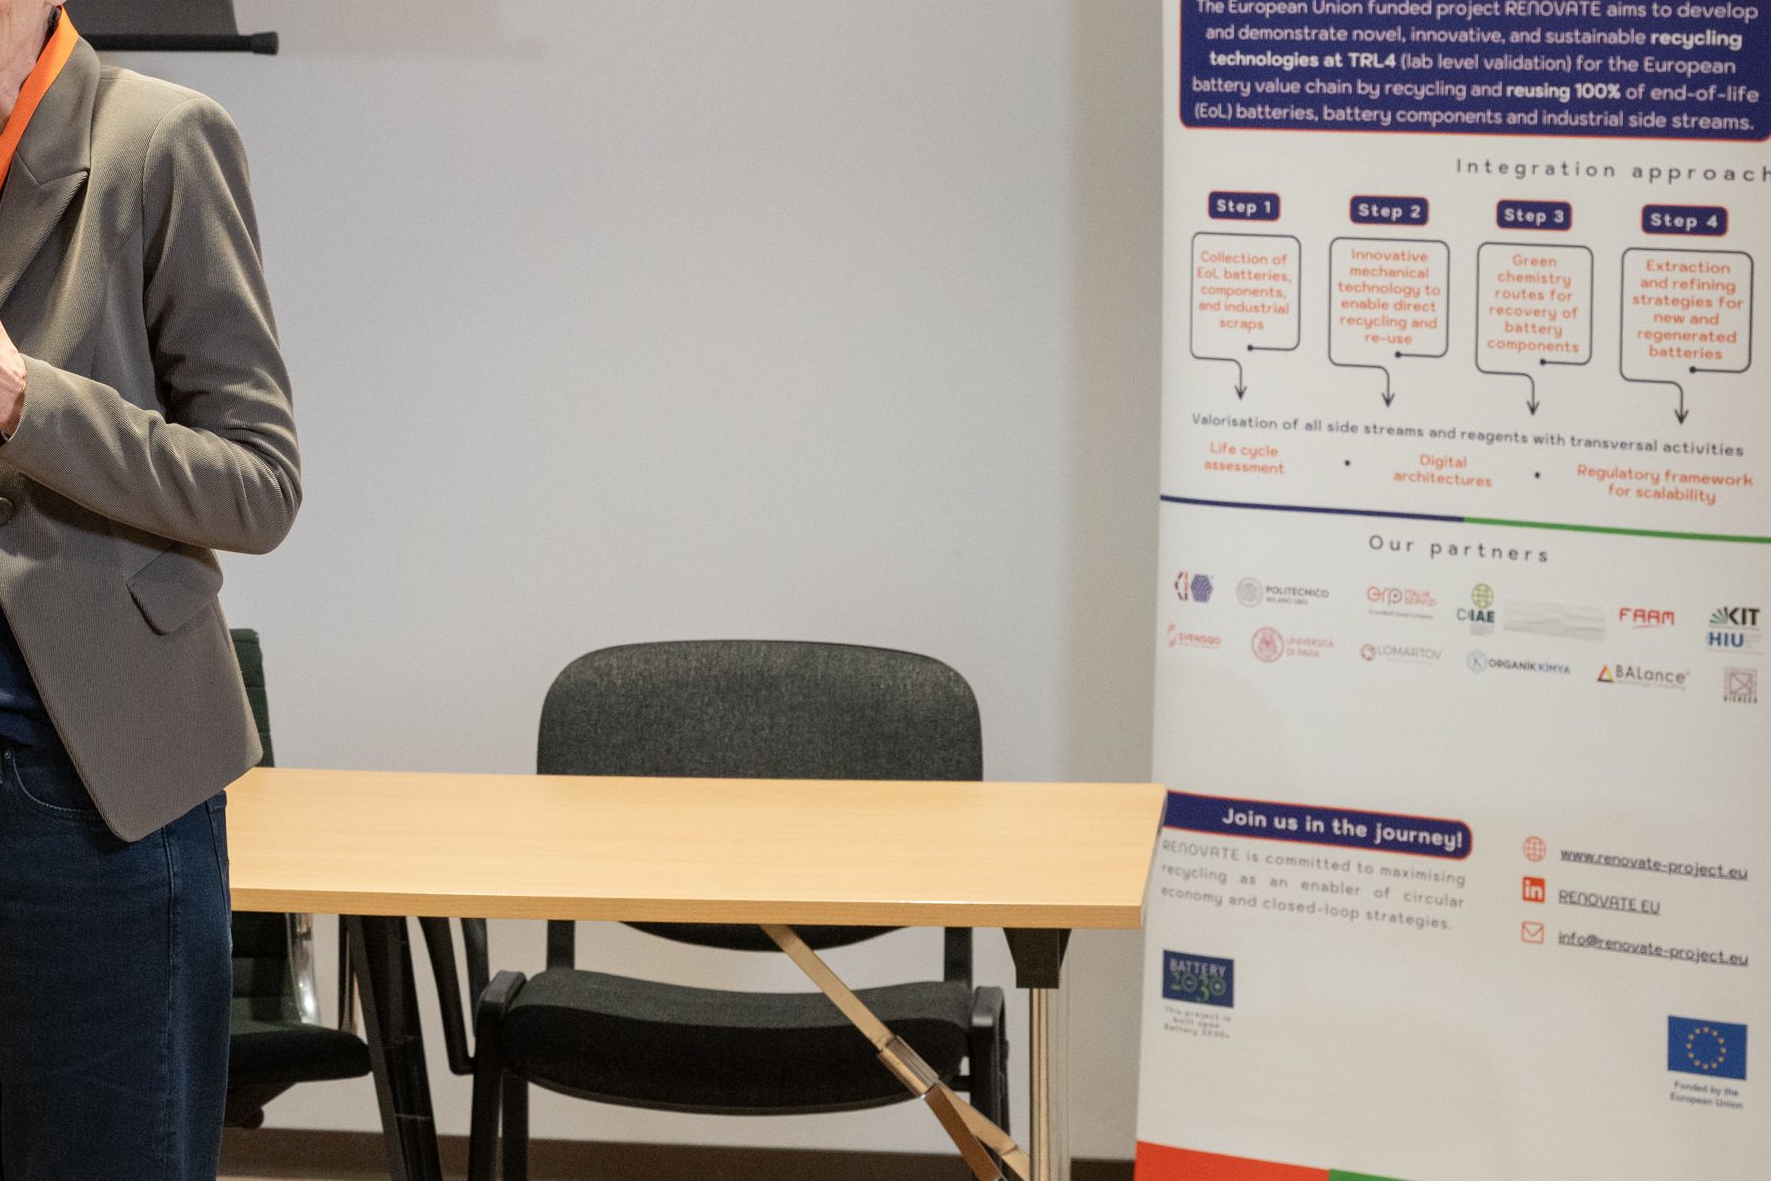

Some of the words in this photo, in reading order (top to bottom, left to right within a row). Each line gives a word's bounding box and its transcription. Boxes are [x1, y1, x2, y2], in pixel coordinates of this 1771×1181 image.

[1312, 0, 1363, 15] Union
[1436, 0, 1500, 21] project
[1505, 0, 1600, 17] RENOVATE
[1607, 1, 1646, 18] aims
[1652, 2, 1672, 18] to
[1677, 2, 1758, 24] develop
[1206, 24, 1234, 40] and
[1238, 24, 1348, 42] demonstrate
[1353, 25, 1406, 42] novel,
[1411, 27, 1505, 44] innovative,
[1510, 28, 1541, 43] and
[1546, 28, 1646, 45] sustainable
[1651, 29, 1742, 50] recycling
[1210, 50, 1319, 72] technologies
[1324, 52, 1343, 68] at
[1348, 51, 1396, 69] TRL4
[1401, 53, 1433, 70] (lab
[1438, 54, 1478, 69] level
[1484, 54, 1571, 72] validation)
[1577, 54, 1602, 72] for
[1609, 56, 1638, 72] the
[1644, 56, 1735, 77] European
[1193, 77, 1250, 97] battery
[1255, 77, 1301, 93] value
[1305, 79, 1352, 94] chain
[1357, 78, 1380, 100] by
[1385, 81, 1466, 101] recycling
[1471, 82, 1502, 97] and
[1506, 83, 1570, 103] reusing
[1575, 82, 1621, 100] 100%
[1626, 83, 1645, 100] of
[1651, 84, 1759, 102] end-of-life
[1195, 102, 1232, 120] (EoL)
[1236, 103, 1318, 122] batteries,
[1323, 105, 1391, 127] battery
[1396, 109, 1502, 128] components
[1507, 109, 1538, 125] and
[1543, 109, 1623, 127] industrial
[1629, 111, 1666, 128] side
[1672, 113, 1753, 130] streams.
[1457, 159, 1615, 180] Integration
[1216, 199, 1257, 218] Step
[1264, 200, 1271, 214] 1
[1357, 204, 1403, 222] Step
[1410, 205, 1421, 219] 2
[1503, 208, 1547, 227] Step
[1553, 209, 1565, 224] 3
[1649, 213, 1698, 233] Step
[1706, 215, 1719, 229] 4
[1193, 415, 1277, 429] Valorisation
[1283, 418, 1298, 430] of
[1305, 420, 1321, 431] all
[1328, 421, 1358, 434] side
[1365, 424, 1423, 437] streams
[1430, 427, 1456, 439] and
[1461, 431, 1528, 445] reagents
[1533, 434, 1565, 446] with
[1570, 435, 1657, 452] transversal
[1663, 441, 1744, 458] activities
[1577, 464, 1660, 486] Regulatory
[1664, 469, 1753, 486] framework
[1607, 484, 1630, 498] for
[1636, 482, 1716, 506] scalability
[1369, 534, 1413, 552] Our
[1430, 543, 1547, 563] partners
[1728, 606, 1761, 627] KIT
[1708, 630, 1745, 648] HIU
[1223, 808, 1266, 827] Join
[1274, 816, 1298, 831] us
[1306, 815, 1324, 833] in
[1332, 818, 1367, 837] the
[1375, 822, 1463, 849] journey!
[1161, 839, 1239, 861] RENOVATE
[1247, 853, 1258, 863] is
[1266, 855, 1350, 872] committed
[1357, 862, 1374, 875] to
[1380, 867, 1465, 889] maximising
[1559, 847, 1749, 881] www.renovate-project.eu
[1161, 862, 1228, 885] recycling
[1240, 874, 1256, 886] as
[1270, 877, 1287, 888] an
[1301, 881, 1360, 895] enabler
[1374, 886, 1390, 899] of
[1404, 892, 1464, 908] circular
[1161, 886, 1222, 908] economy
[1229, 896, 1257, 908] and
[1263, 897, 1359, 921] closed-loop
[1366, 910, 1453, 932] strategies.
[1559, 889, 1636, 911] RENOVATE
[1641, 899, 1661, 915] EU
[1558, 930, 1750, 967] info@renovate-project.eu
[1169, 958, 1227, 977] BATTERY
